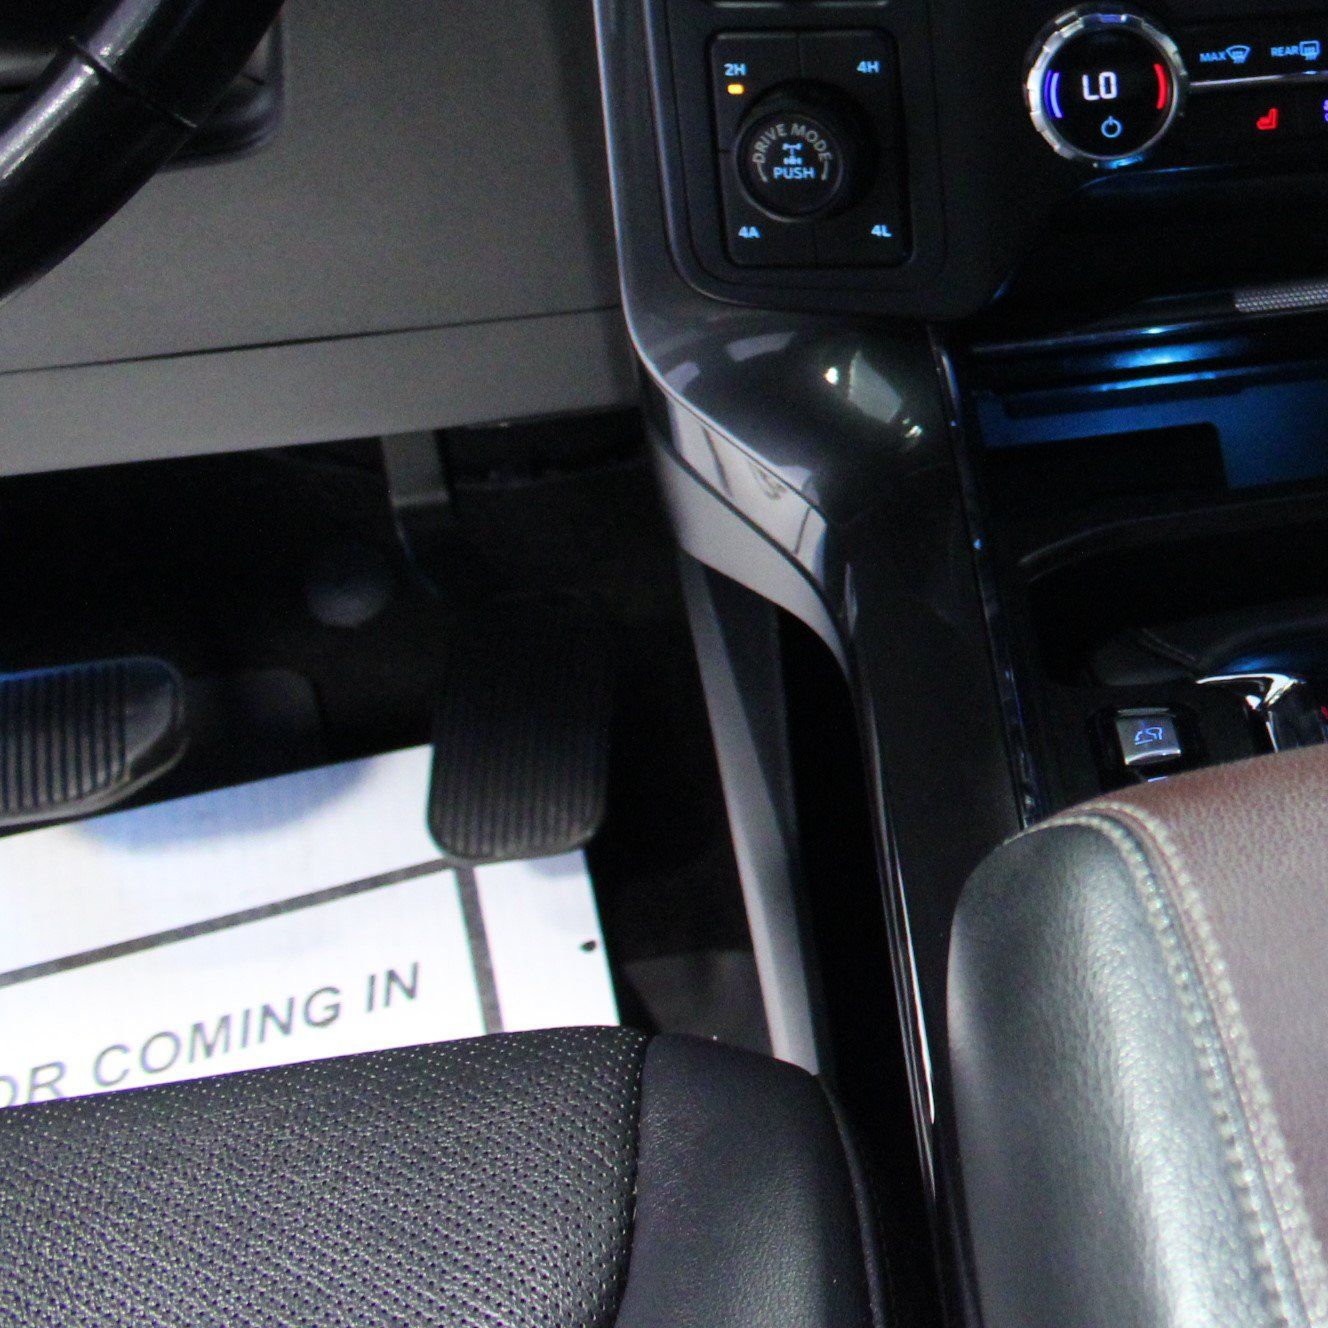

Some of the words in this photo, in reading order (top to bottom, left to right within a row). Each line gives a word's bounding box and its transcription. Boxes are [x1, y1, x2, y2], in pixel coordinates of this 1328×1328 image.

[1200, 51, 1226, 64] MAX
[1271, 44, 1299, 58] REAR
[724, 63, 747, 76] 2H
[856, 60, 881, 74] 4H
[1082, 72, 1118, 102] LO
[752, 123, 787, 164] DRIVE
[791, 123, 832, 161] MODE
[773, 166, 816, 180] PUSH
[738, 225, 762, 239] 4A
[870, 224, 893, 238] 4L
[92, 985, 342, 1088] COMING
[365, 962, 420, 1013] IN
